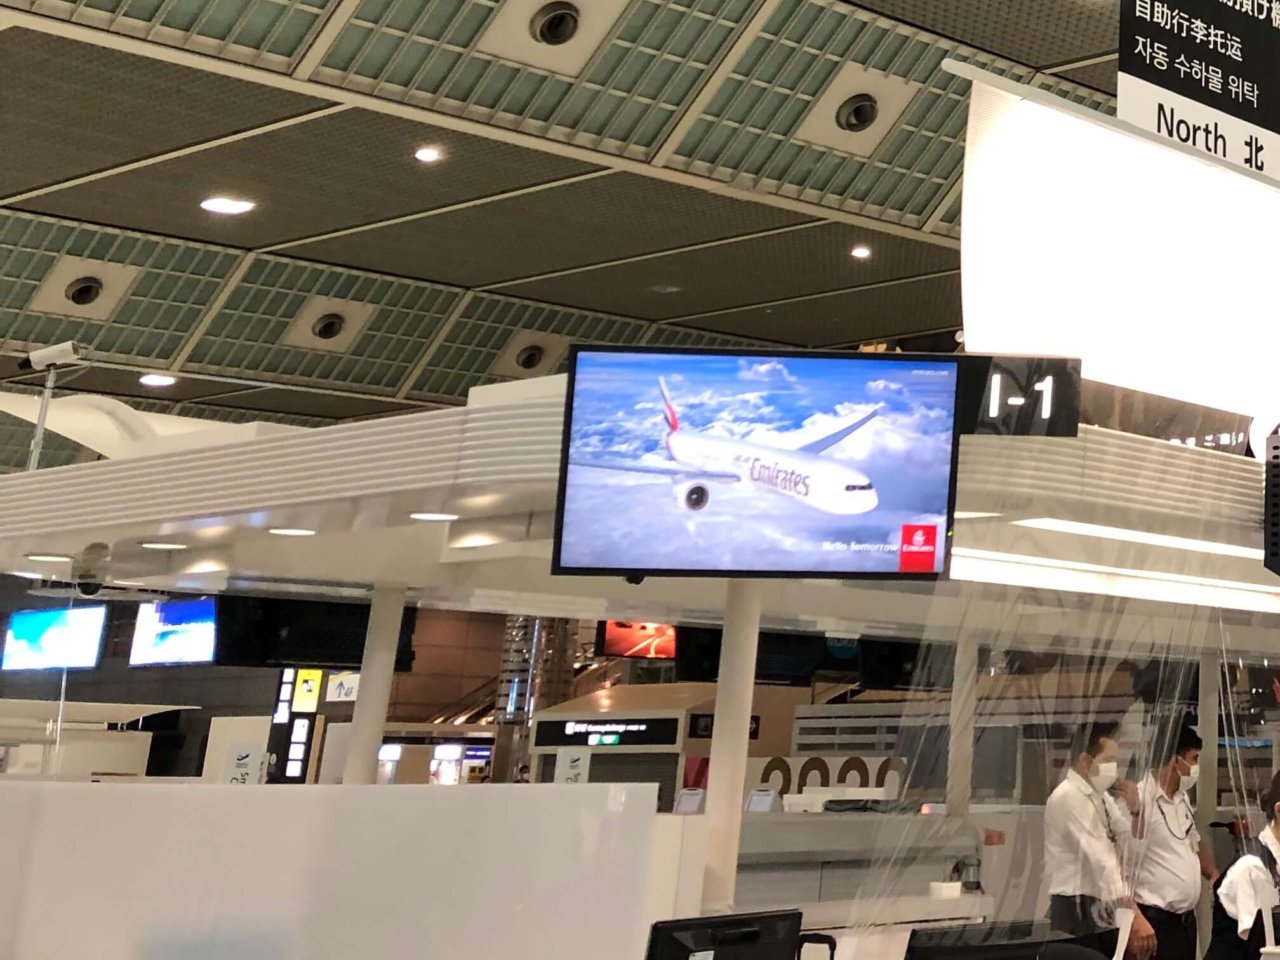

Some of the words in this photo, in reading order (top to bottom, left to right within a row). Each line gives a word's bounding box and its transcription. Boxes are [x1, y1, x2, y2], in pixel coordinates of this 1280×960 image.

[1134, 35, 1169, 71] 자동
[1174, 54, 1223, 94] 수하물
[1228, 75, 1259, 108] 위탁
[1157, 102, 1226, 158] North
[1244, 135, 1264, 171] 北
[989, 373, 1053, 419] I-1
[750, 457, 810, 496] Emirates
